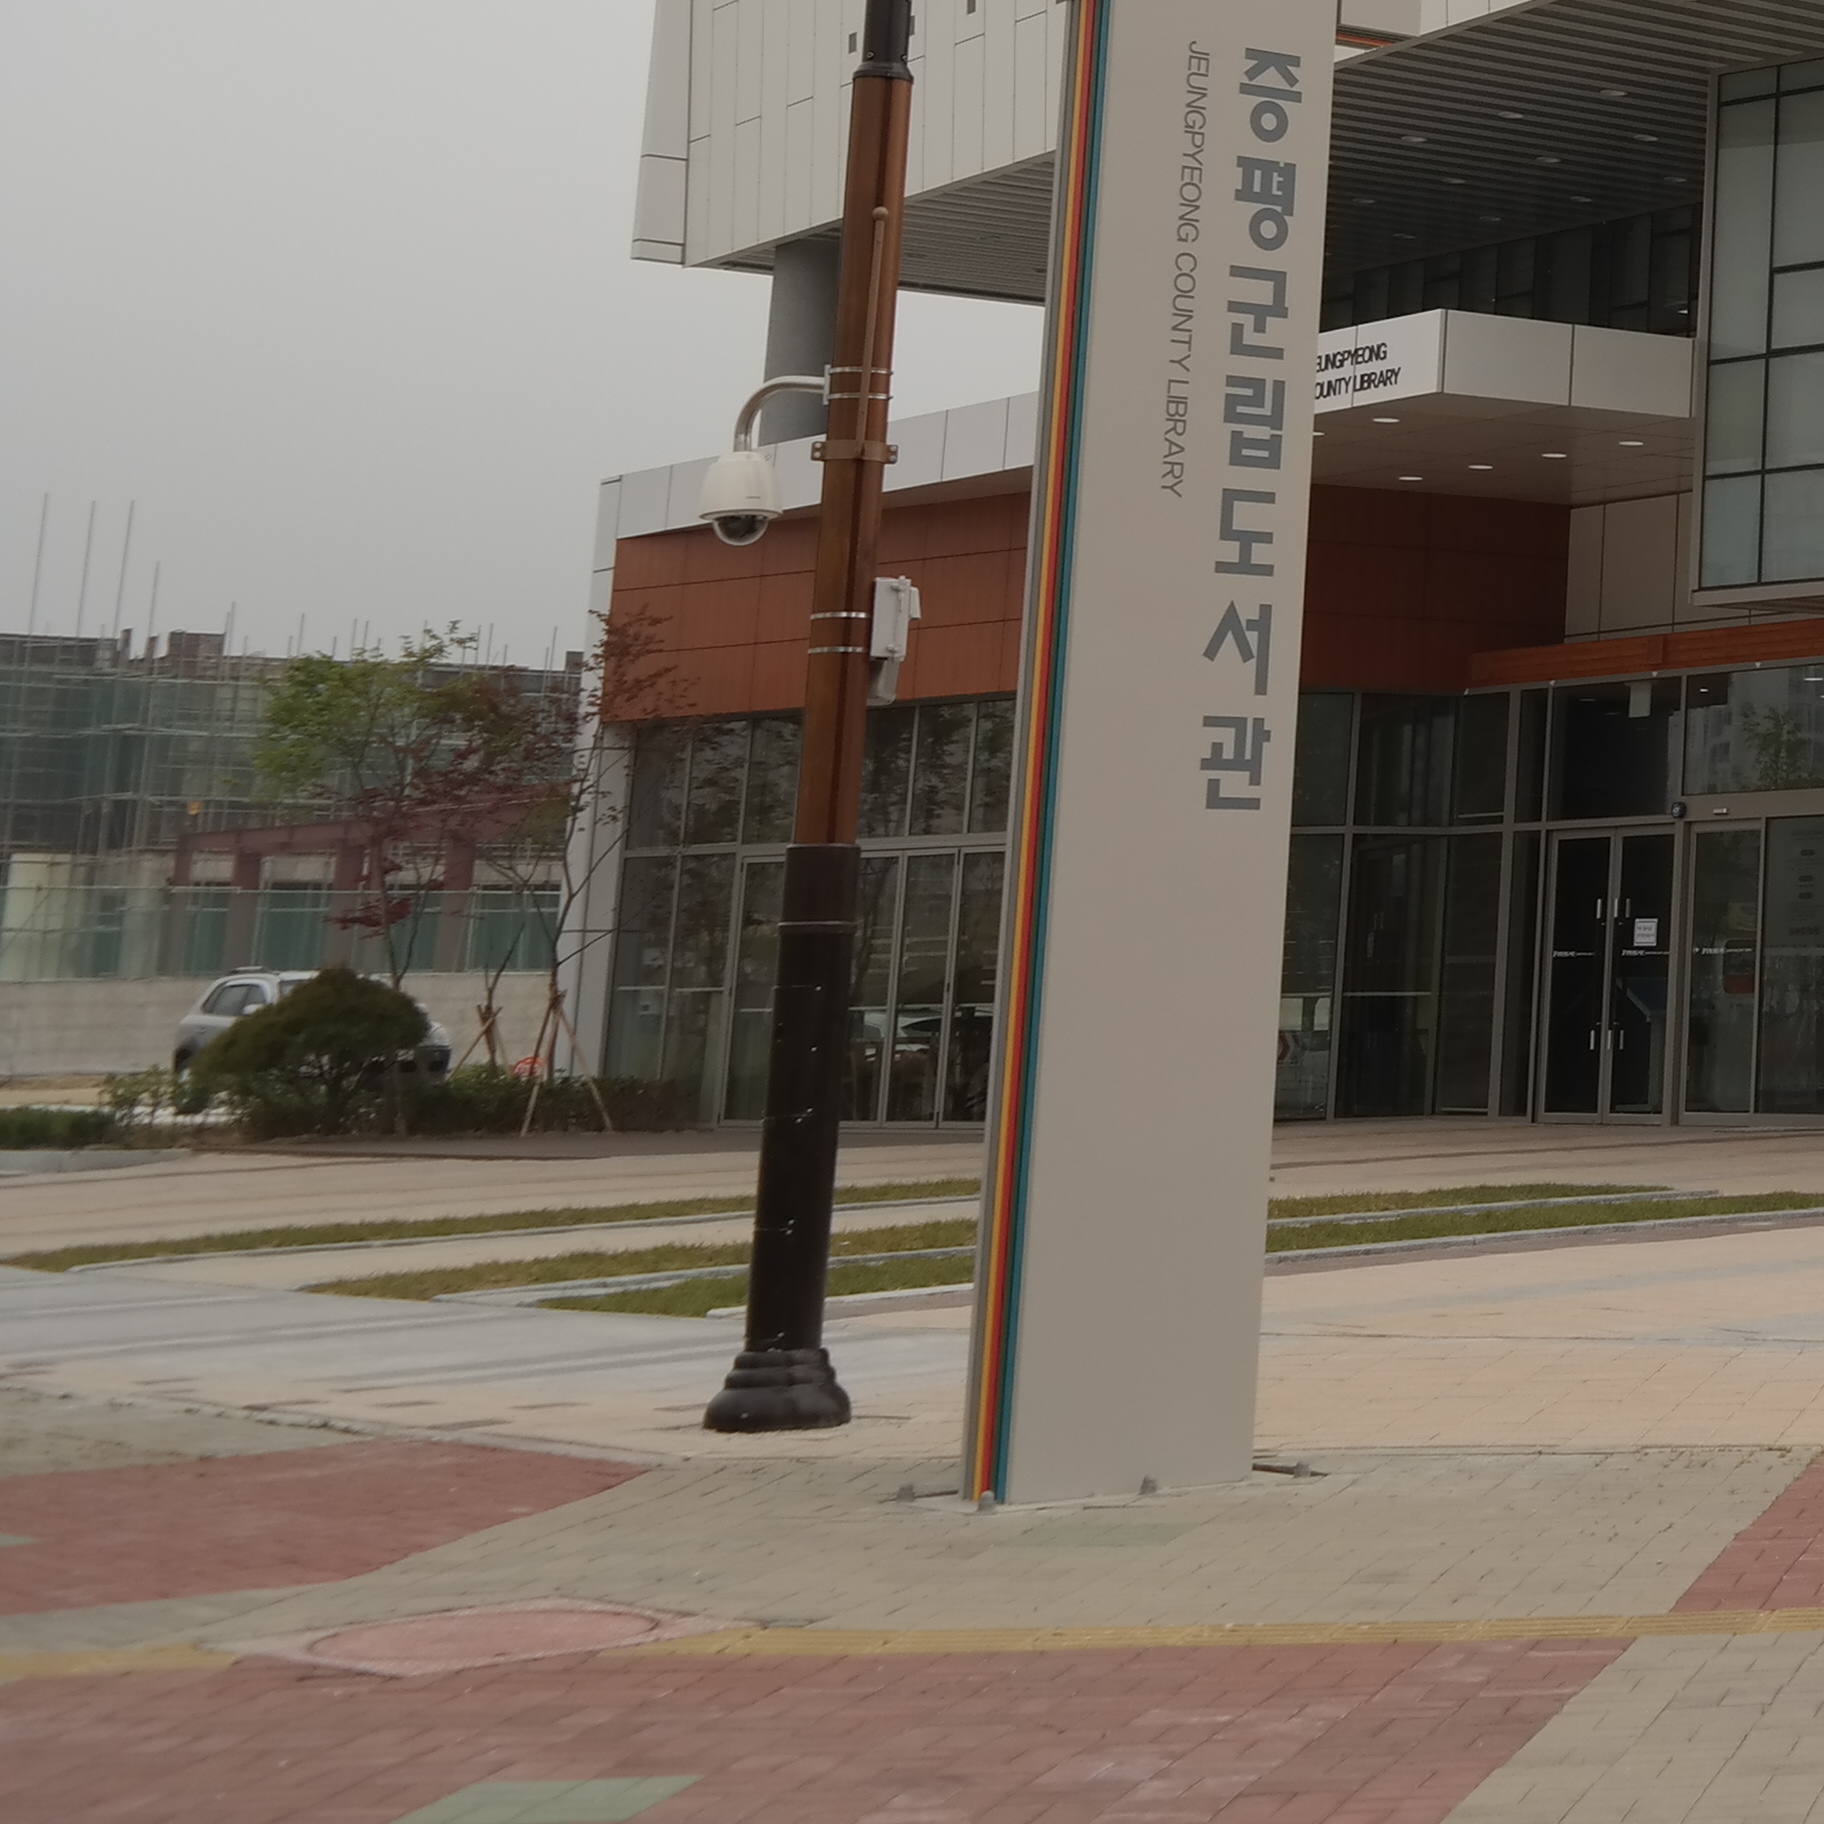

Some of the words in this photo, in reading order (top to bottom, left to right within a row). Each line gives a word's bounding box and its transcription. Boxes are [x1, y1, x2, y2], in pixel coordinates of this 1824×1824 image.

[1176, 40, 1210, 243] JEUNGPYEONG
[1169, 252, 1198, 373] COUNTY
[1316, 342, 1387, 373] EUNGPYEONG
[1161, 379, 1190, 498] LIBRARY
[1200, 46, 1302, 811] 증평군립도서관
[1315, 376, 1352, 400] OUNTY
[1353, 367, 1401, 393] LIBRARY
